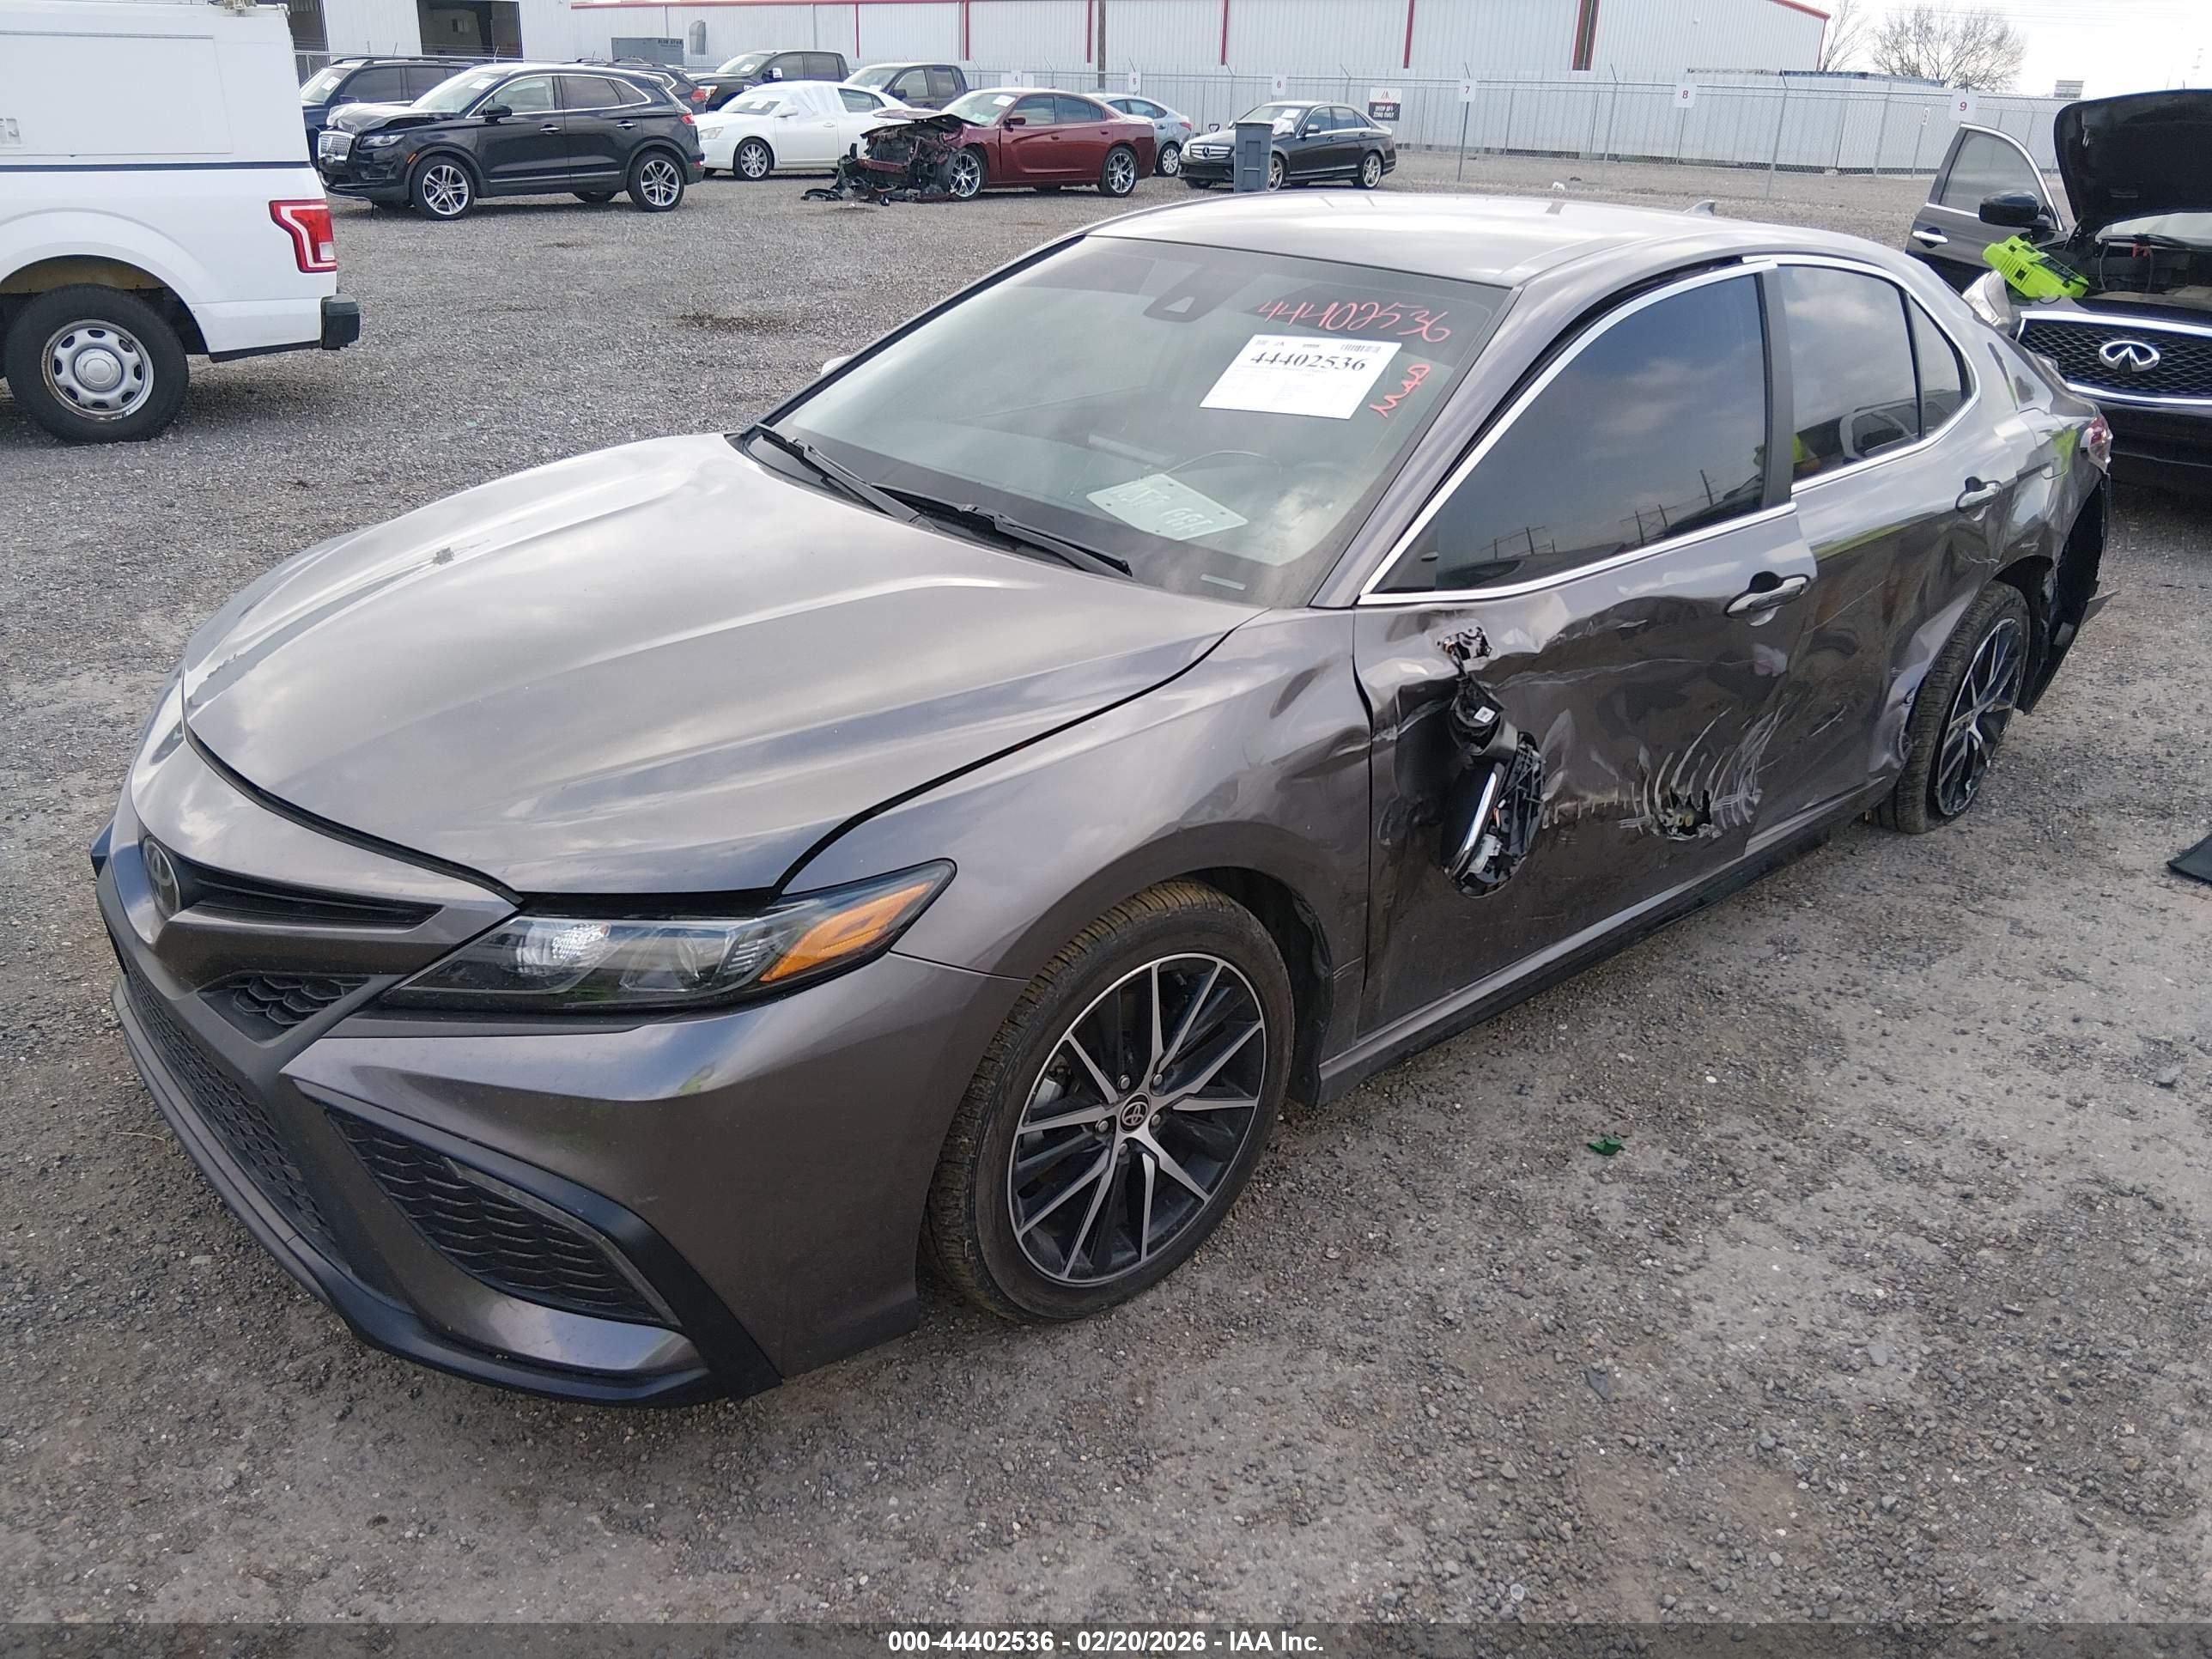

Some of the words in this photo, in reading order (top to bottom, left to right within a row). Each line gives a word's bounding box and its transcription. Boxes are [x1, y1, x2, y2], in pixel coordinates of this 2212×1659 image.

[1465, 86, 1471, 94] 7
[1682, 90, 1689, 100] 8
[1959, 101, 1967, 112] 9
[1257, 300, 1451, 343] 44402536
[1250, 350, 1367, 372] 44402536
